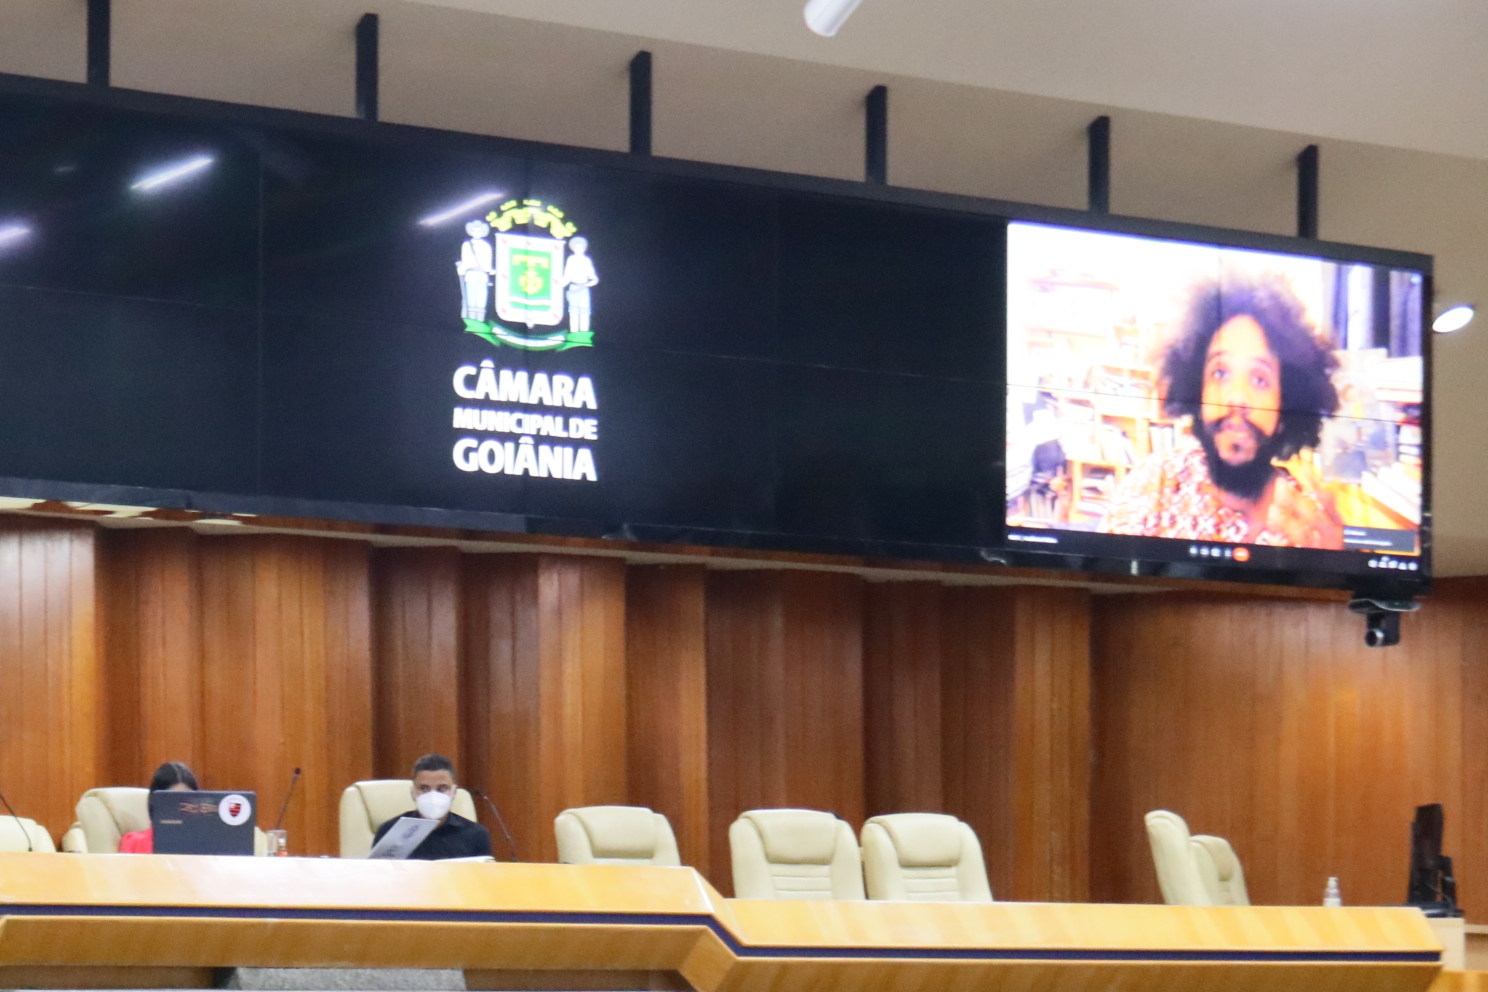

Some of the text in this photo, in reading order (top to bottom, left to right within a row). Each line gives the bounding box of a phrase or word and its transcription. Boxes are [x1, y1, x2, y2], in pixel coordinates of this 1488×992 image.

[452, 359, 598, 410] CÂMARA
[452, 407, 598, 440] MUNICIPAL DE
[452, 436, 598, 482] GOIÂNIA
